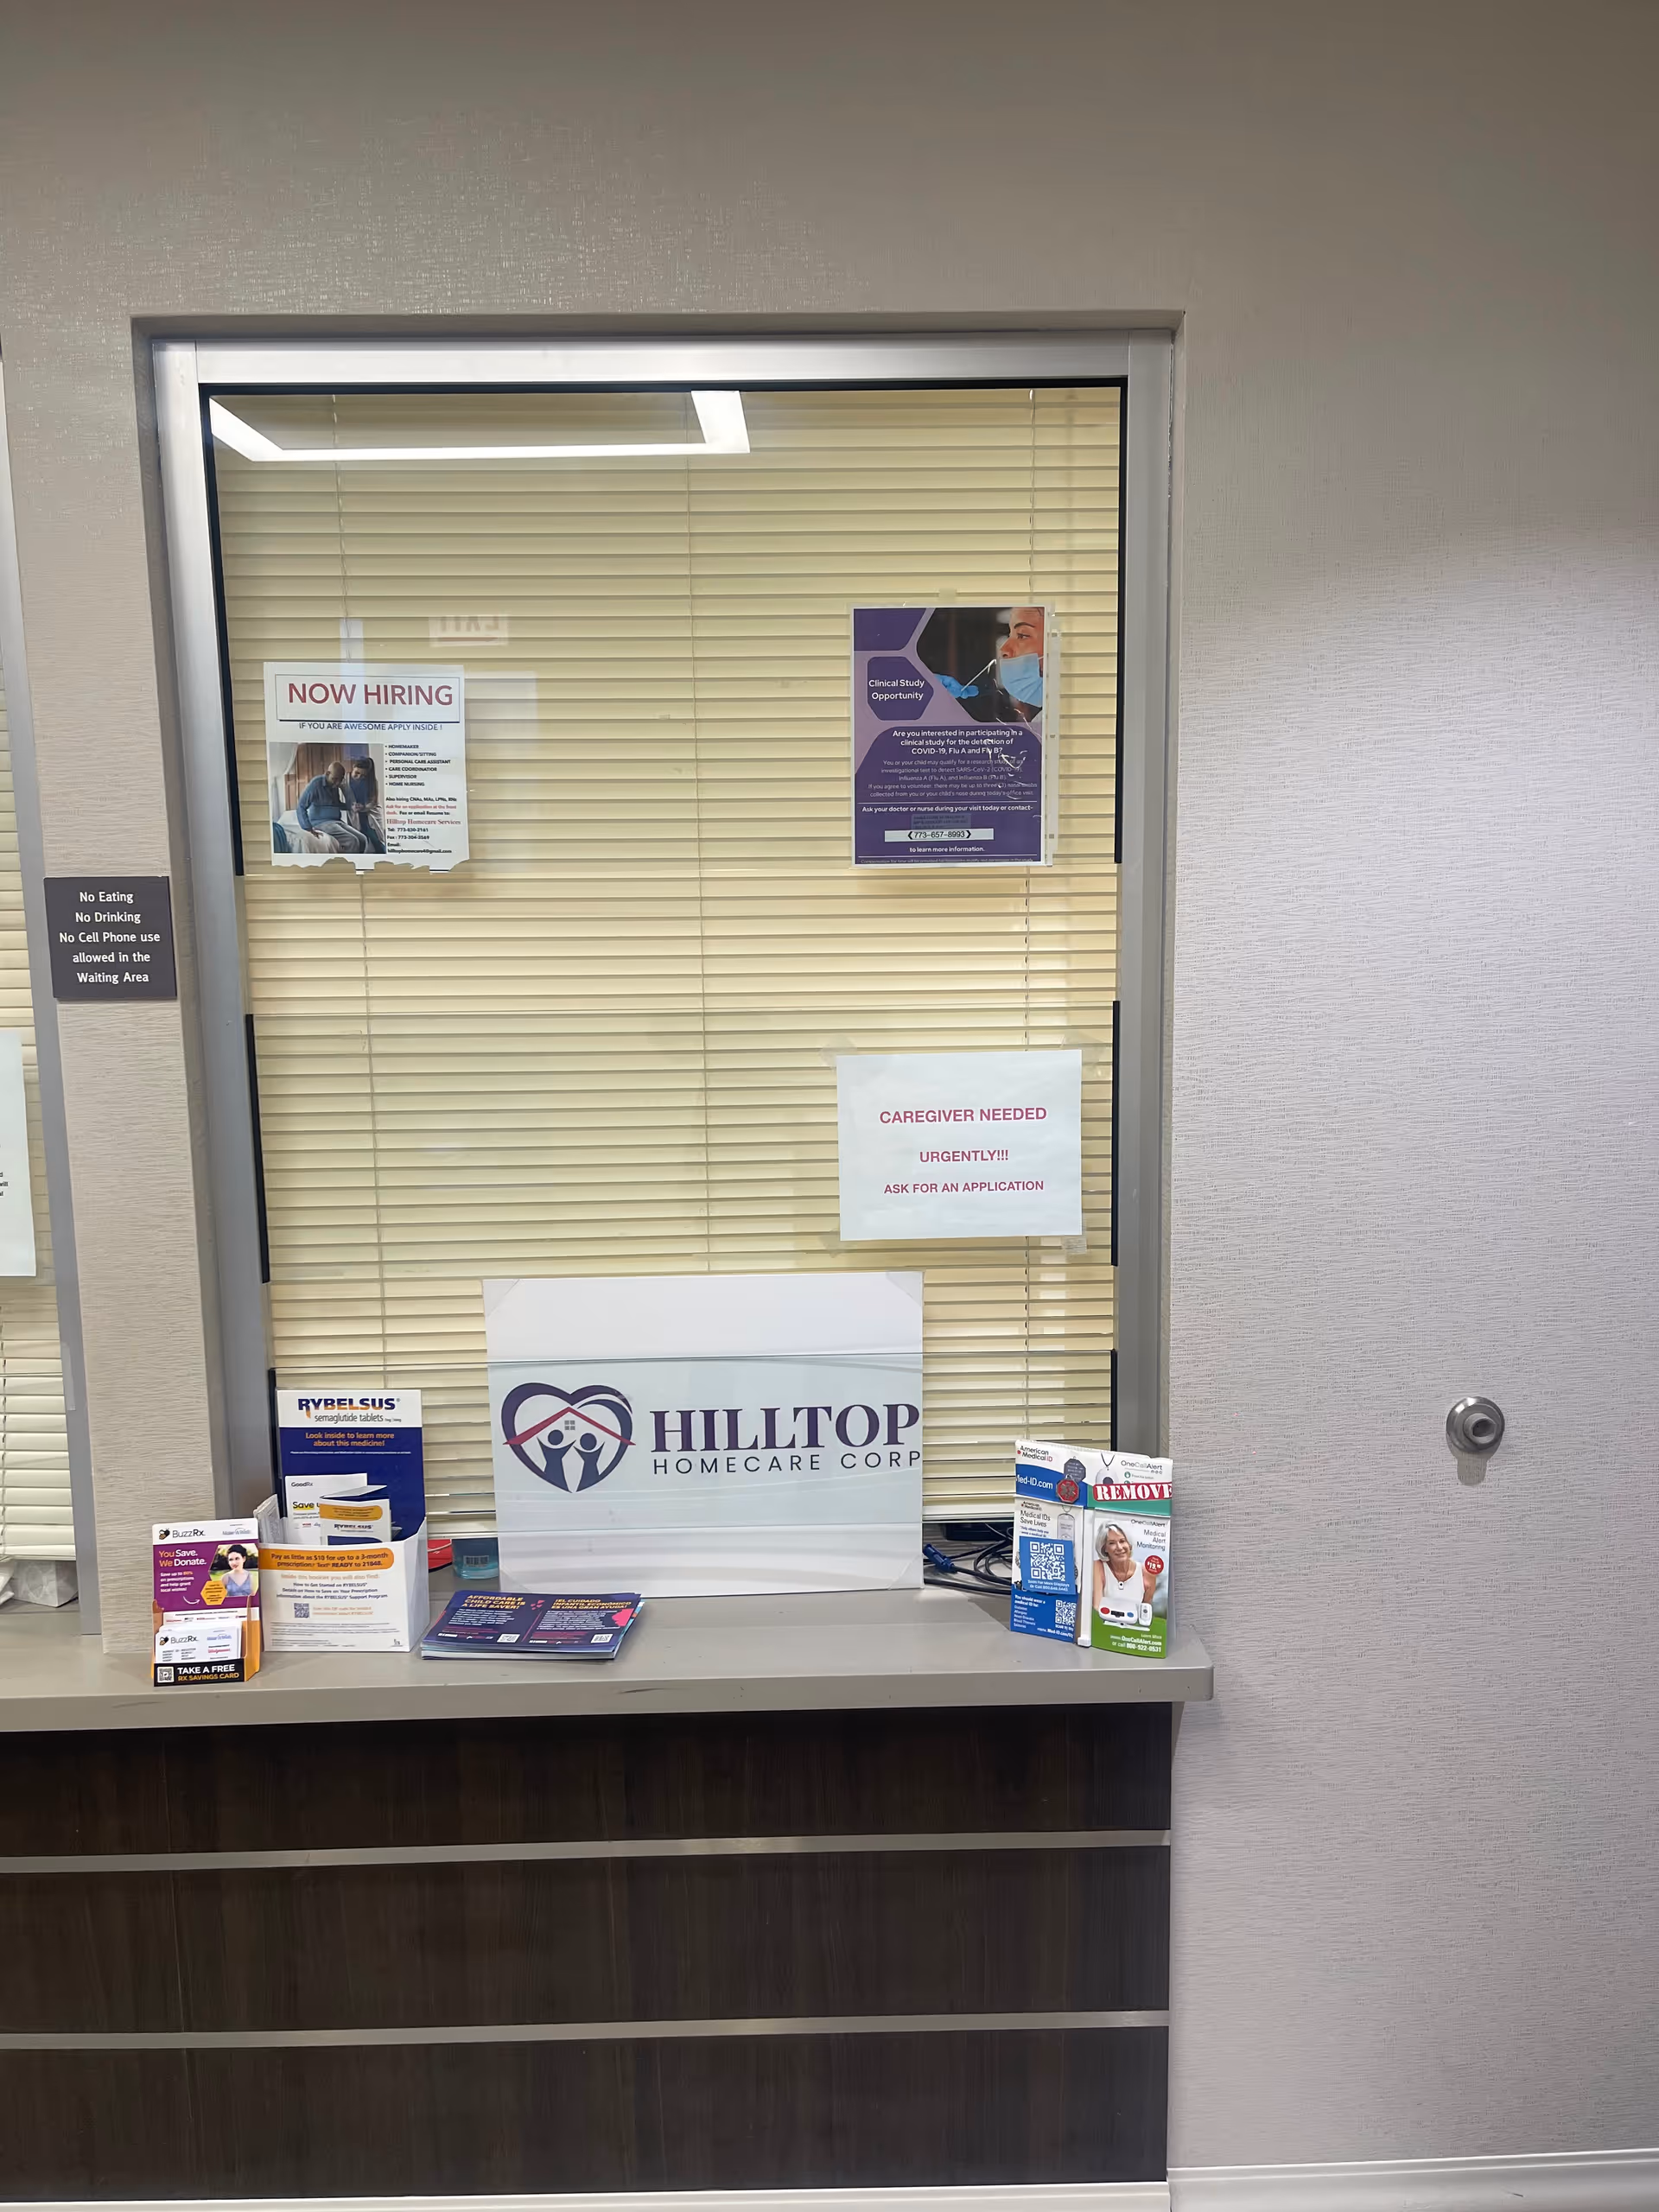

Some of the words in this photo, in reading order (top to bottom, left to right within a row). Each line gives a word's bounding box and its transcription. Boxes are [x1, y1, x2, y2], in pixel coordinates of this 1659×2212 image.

[899, 679, 925, 688] Study
[289, 683, 356, 704] NOW
[364, 684, 453, 706] HIRING
[871, 691, 923, 701] Opportunity
[79, 892, 94, 902] No
[99, 892, 133, 904] Eating
[76, 912, 90, 922] No
[95, 912, 141, 924] Drinking
[60, 932, 74, 943] No
[78, 932, 99, 942] Cell
[103, 932, 136, 942] Phone
[73, 952, 114, 963] allowed
[118, 952, 128, 962] in
[132, 952, 150, 962] the
[77, 972, 118, 984] Waiting
[123, 972, 149, 982] Area
[880, 1109, 973, 1124] CAREGIVER
[980, 1107, 1047, 1121] NEEDED
[920, 1150, 1009, 1162] URGENTLY!!!
[884, 1184, 908, 1194] ASK
[913, 1183, 937, 1193] FOR
[941, 1183, 957, 1192] AN
[962, 1181, 1044, 1192] APPLICATION
[315, 1413, 357, 1424] semaglutide
[359, 1413, 383, 1422] tablets
[650, 1404, 920, 1454] HILLTOP
[1020, 1445, 1049, 1455] American
[1022, 1452, 1046, 1461] Medical
[654, 1454, 819, 1474] HOMECARE
[840, 1451, 920, 1469] CORP
[1121, 1460, 1163, 1470] OneCallAlert
[1096, 1483, 1172, 1501] REMOVE
[1020, 1510, 1041, 1519] Medical
[1020, 1517, 1032, 1525] Save
[1137, 1541, 1165, 1551] Monitoring
[174, 1558, 206, 1566] Donate.
[212, 1664, 235, 1673] FREE
